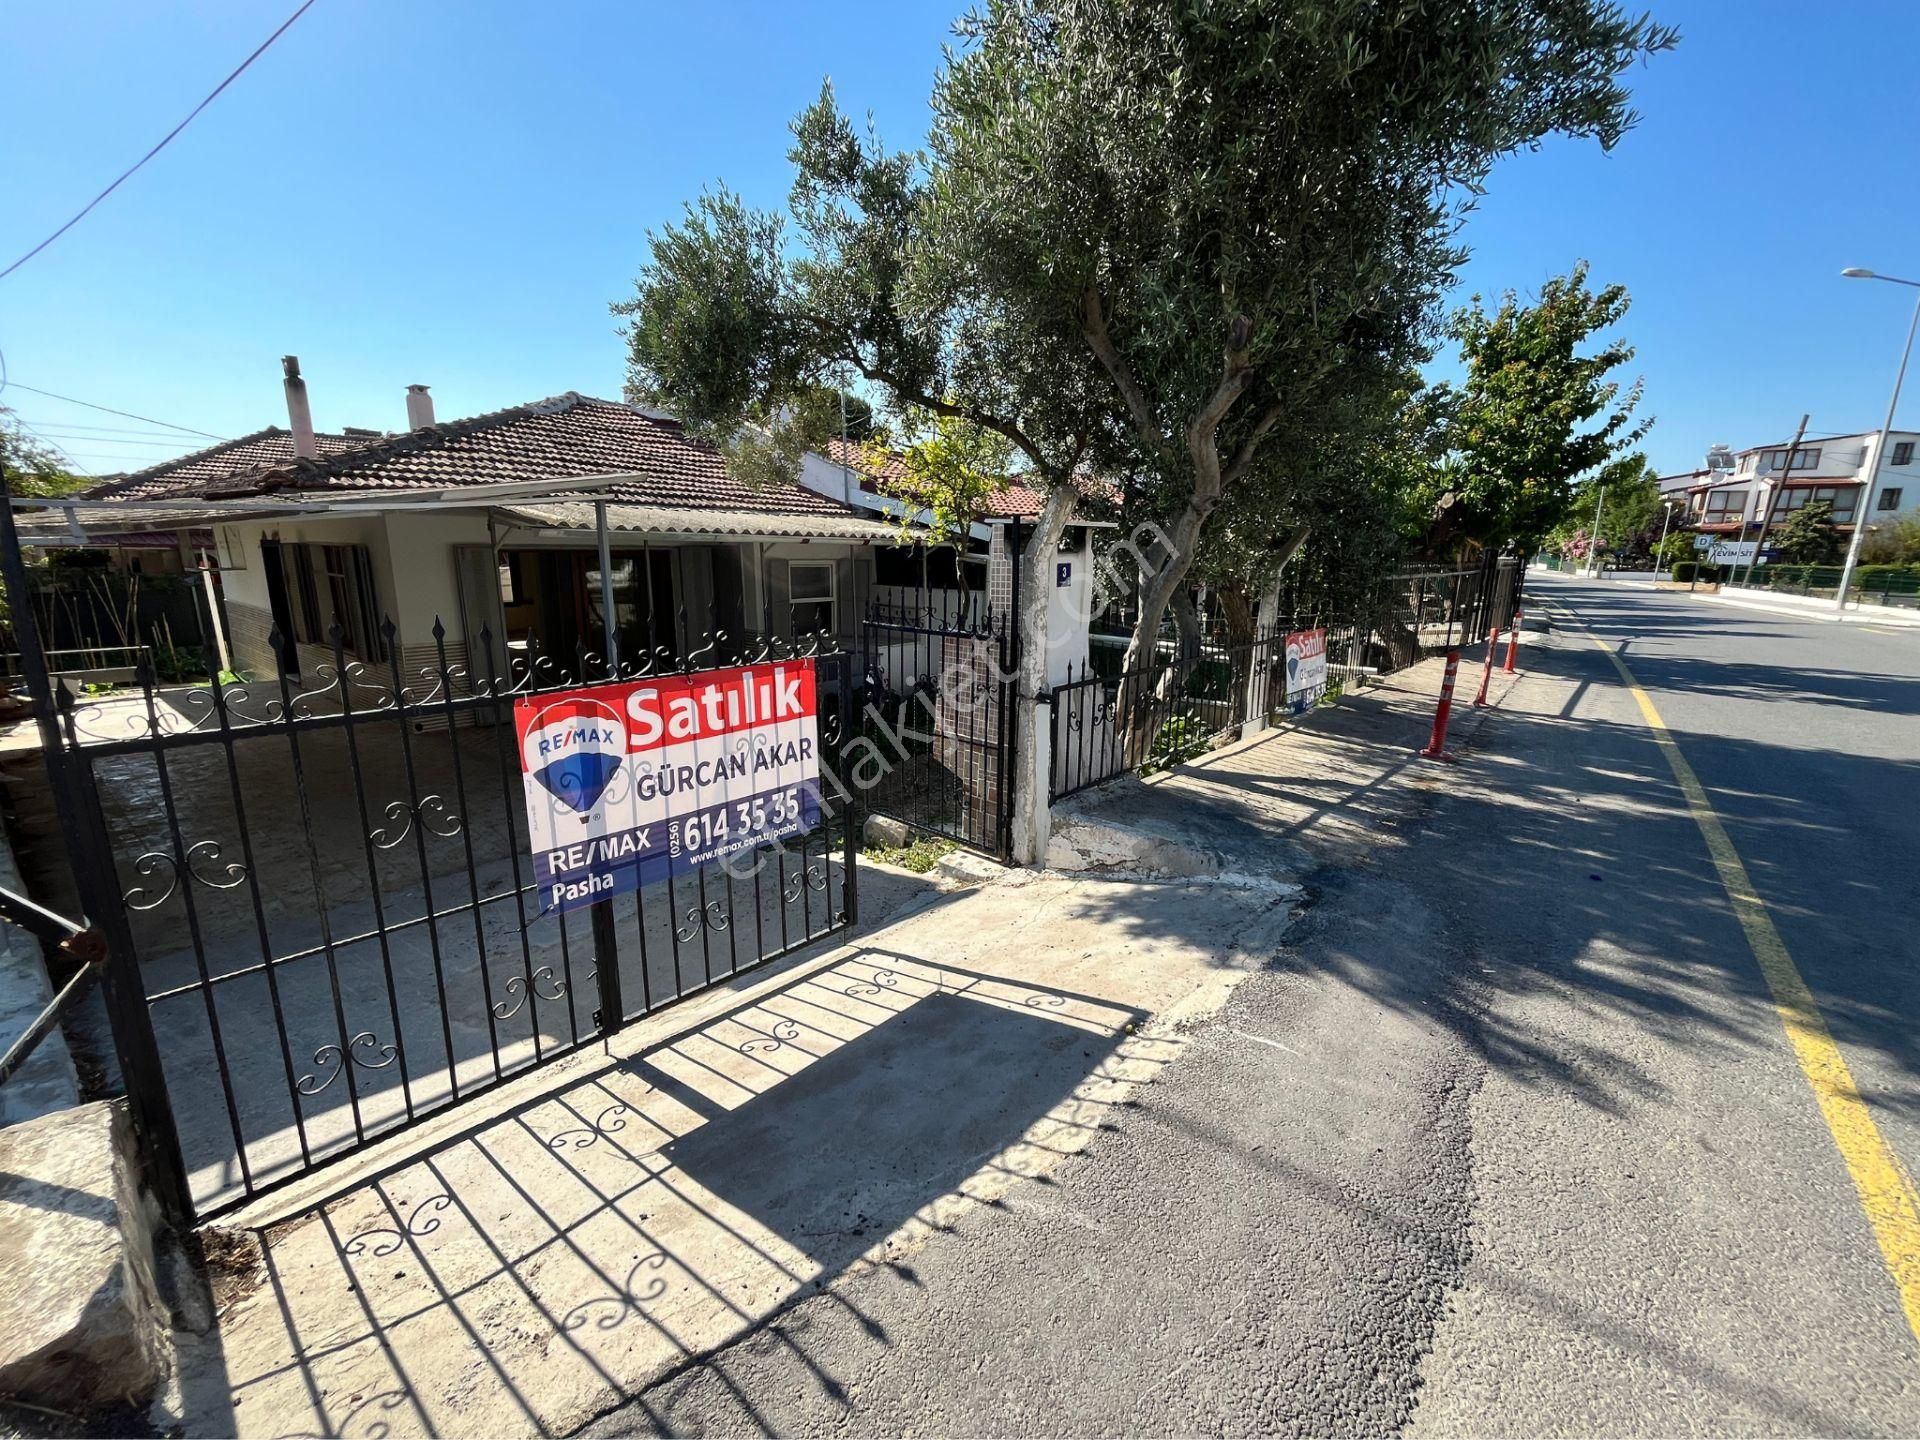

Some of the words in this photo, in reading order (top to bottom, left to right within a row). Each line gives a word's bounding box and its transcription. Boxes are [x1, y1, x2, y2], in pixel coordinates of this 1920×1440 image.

[1062, 566, 1067, 578] 3
[626, 666, 804, 746] Satılık
[538, 727, 614, 757] RE/MAX
[637, 751, 747, 802] GÜRCAN
[753, 737, 813, 774] AKAR
[669, 820, 681, 859] (0256)
[684, 808, 730, 852] 614
[736, 797, 766, 836] 35
[771, 787, 799, 825] 35
[690, 822, 798, 865] www.remax.com.tr/pasha
[548, 827, 652, 876] RE/MAX
[552, 872, 614, 906] Pasha
